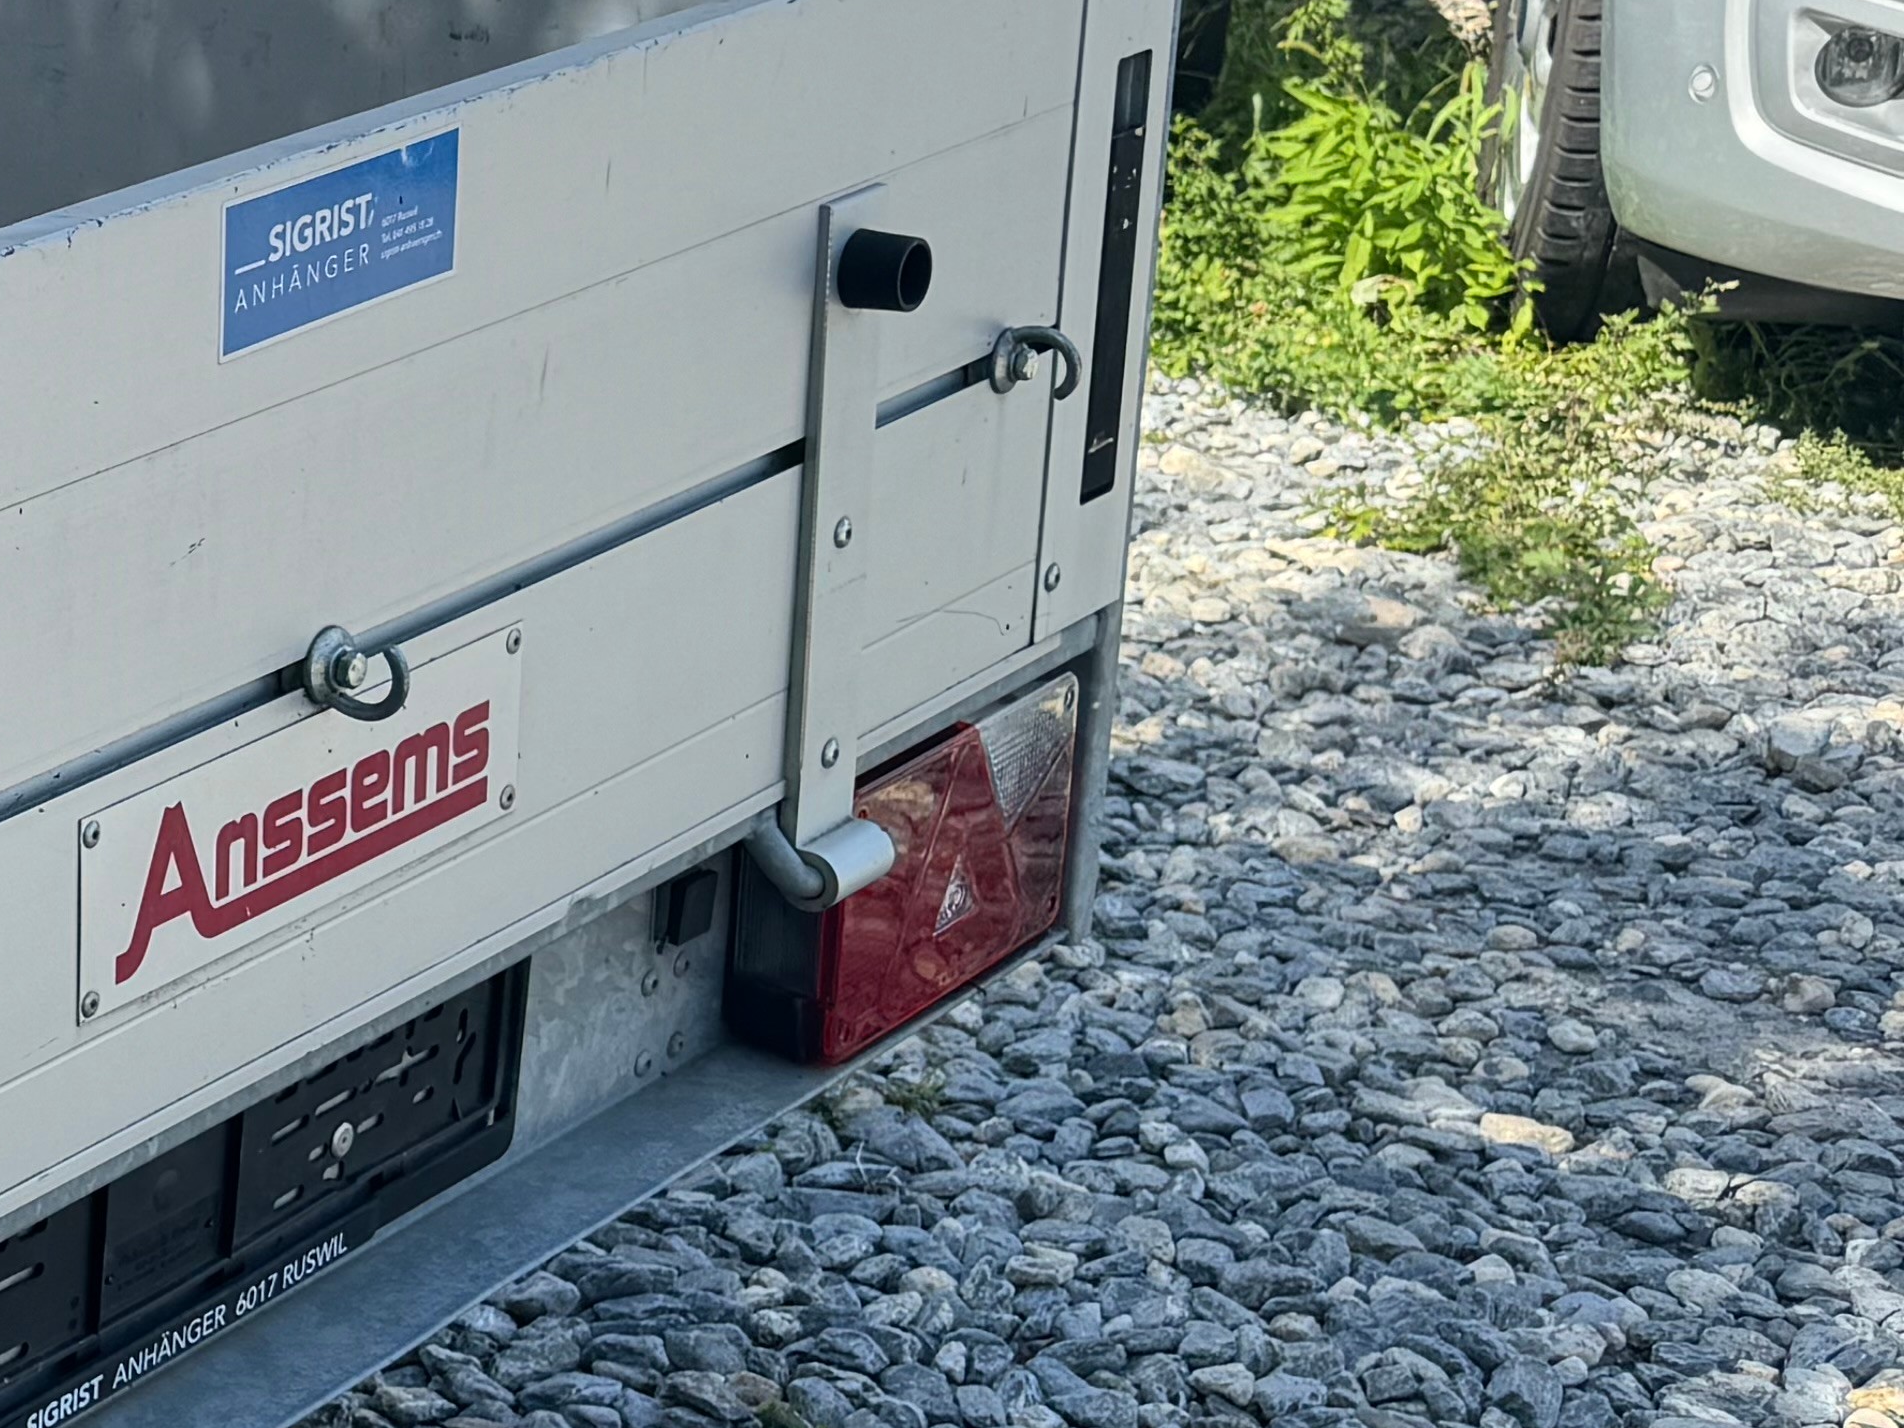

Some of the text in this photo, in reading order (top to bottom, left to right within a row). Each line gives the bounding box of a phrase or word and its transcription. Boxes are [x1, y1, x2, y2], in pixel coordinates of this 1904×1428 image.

[234, 244, 369, 313] ANHÄNGER
[268, 193, 372, 262] SIGRIST
[115, 699, 490, 985] Anssems
[112, 1304, 227, 1389] ANHÄNGER
[235, 1272, 277, 1317] 6017
[282, 1232, 347, 1289] RUSWIL
